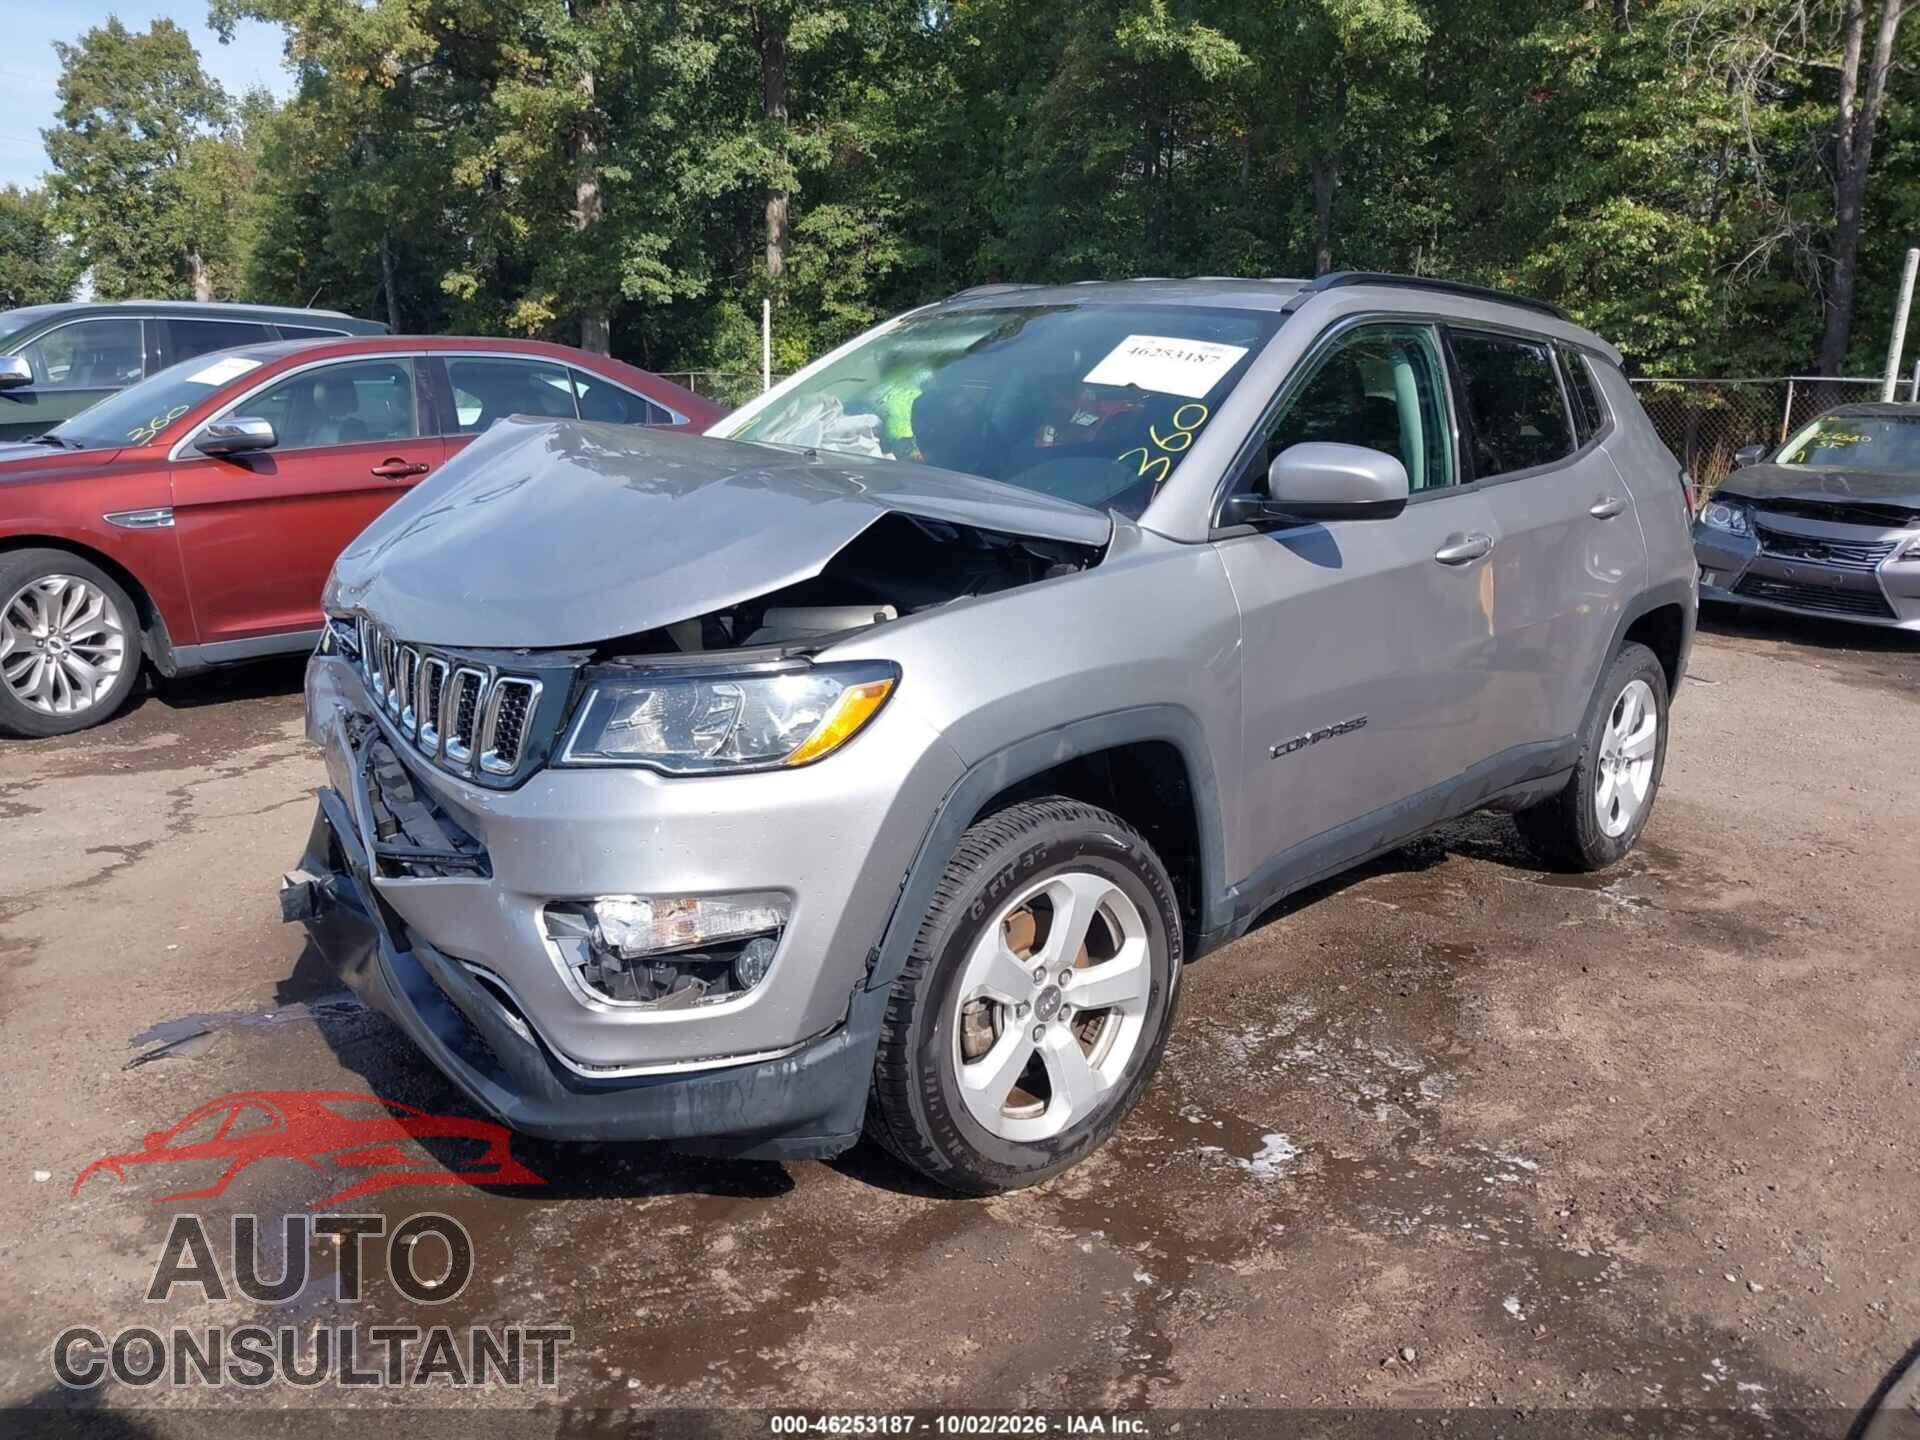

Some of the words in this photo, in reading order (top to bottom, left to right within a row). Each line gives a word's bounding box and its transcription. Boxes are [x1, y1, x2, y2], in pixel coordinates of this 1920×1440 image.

[127, 404, 190, 446] 360
[1118, 403, 1208, 482] 360
[1270, 715, 1368, 760] COMPASS
